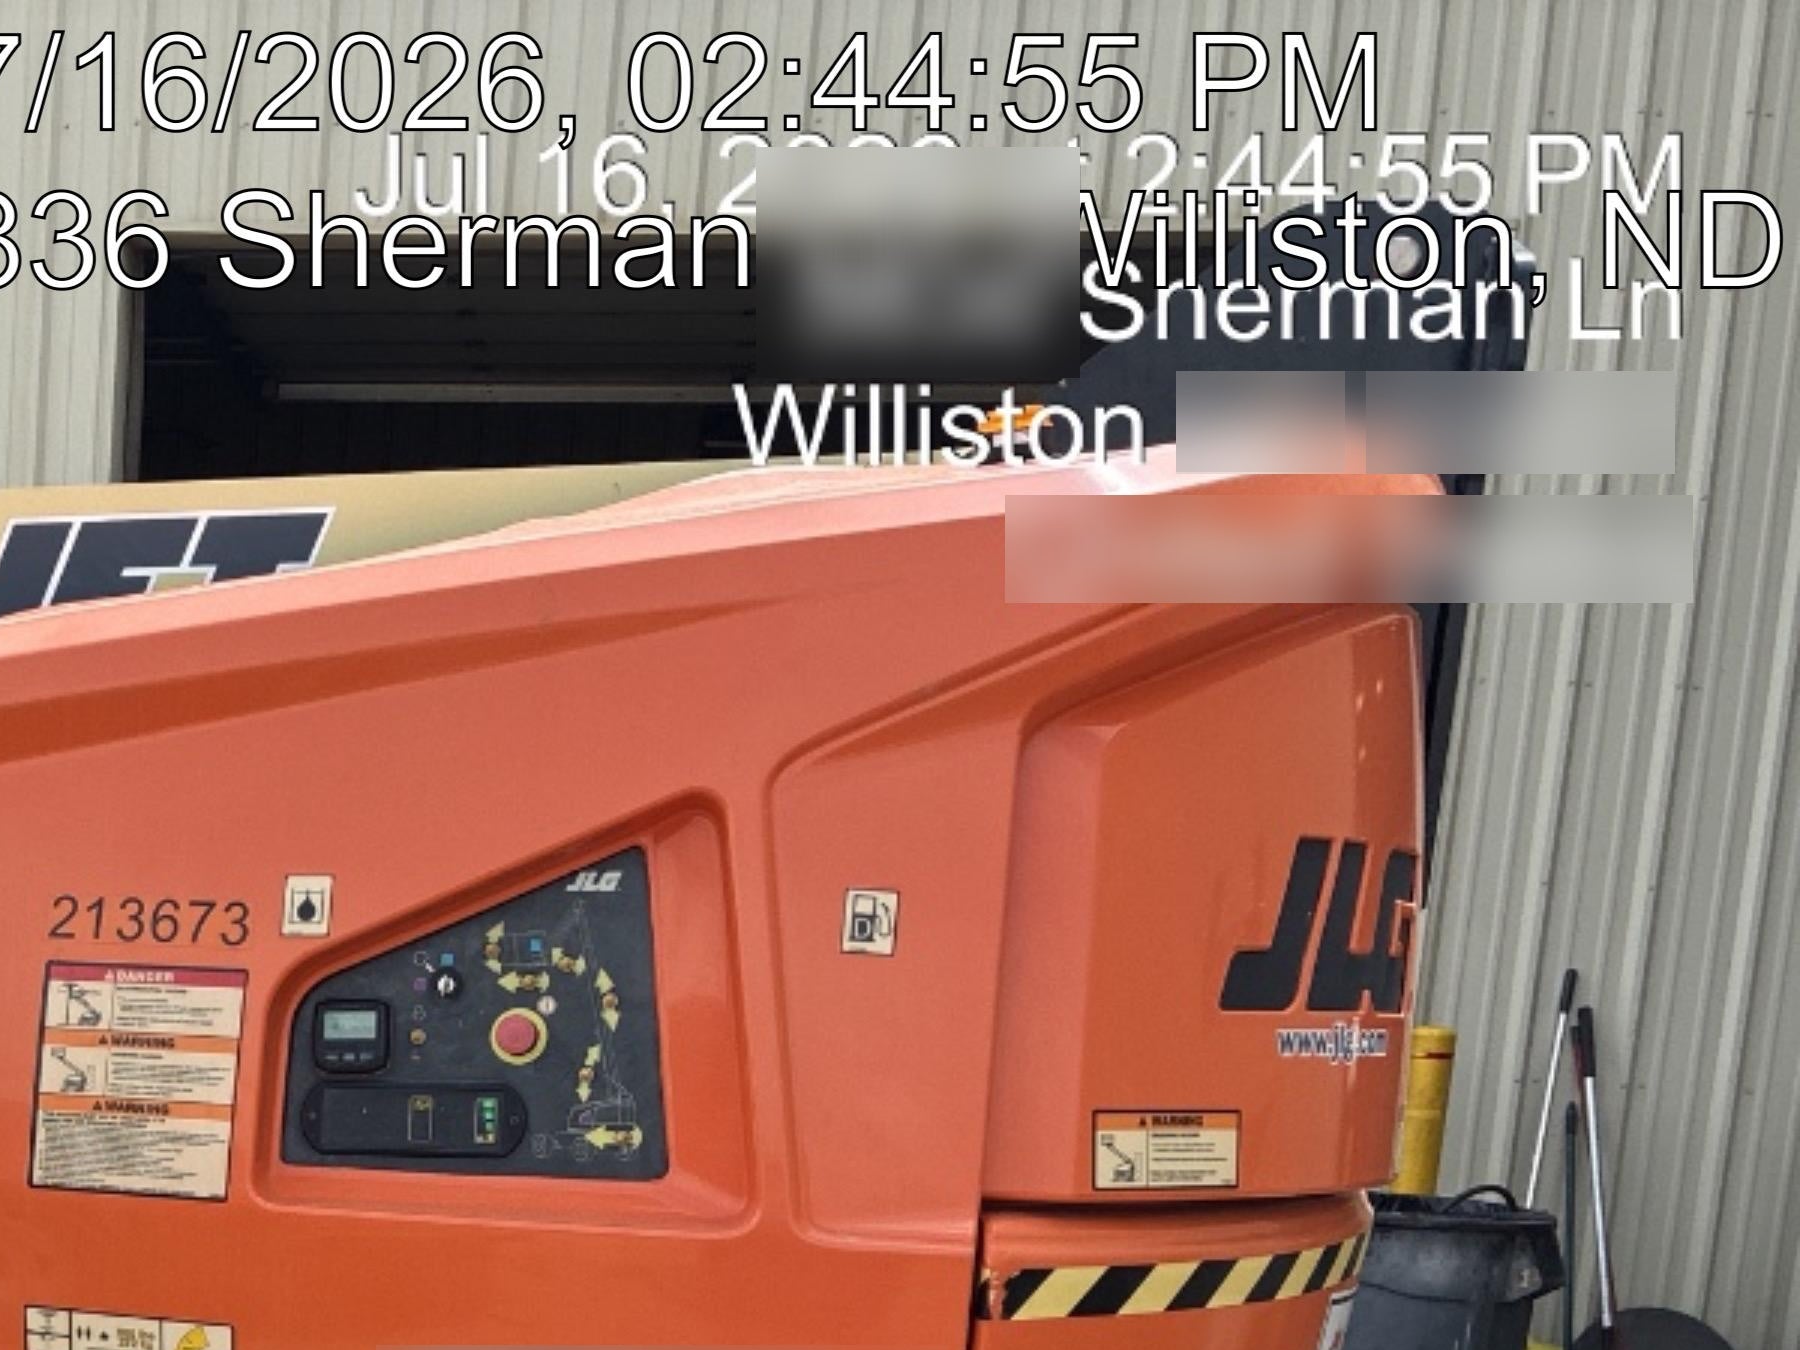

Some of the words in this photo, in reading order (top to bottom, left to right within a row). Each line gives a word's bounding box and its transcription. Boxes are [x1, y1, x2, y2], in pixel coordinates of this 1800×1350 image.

[566, 871, 623, 892] JLG
[48, 894, 249, 946] 213673
[1218, 835, 1418, 1013] JLG
[116, 970, 175, 983] DANGER
[111, 1034, 175, 1049] WARNING
[103, 1100, 169, 1116] WARNING
[1151, 1115, 1203, 1126] WARNING
